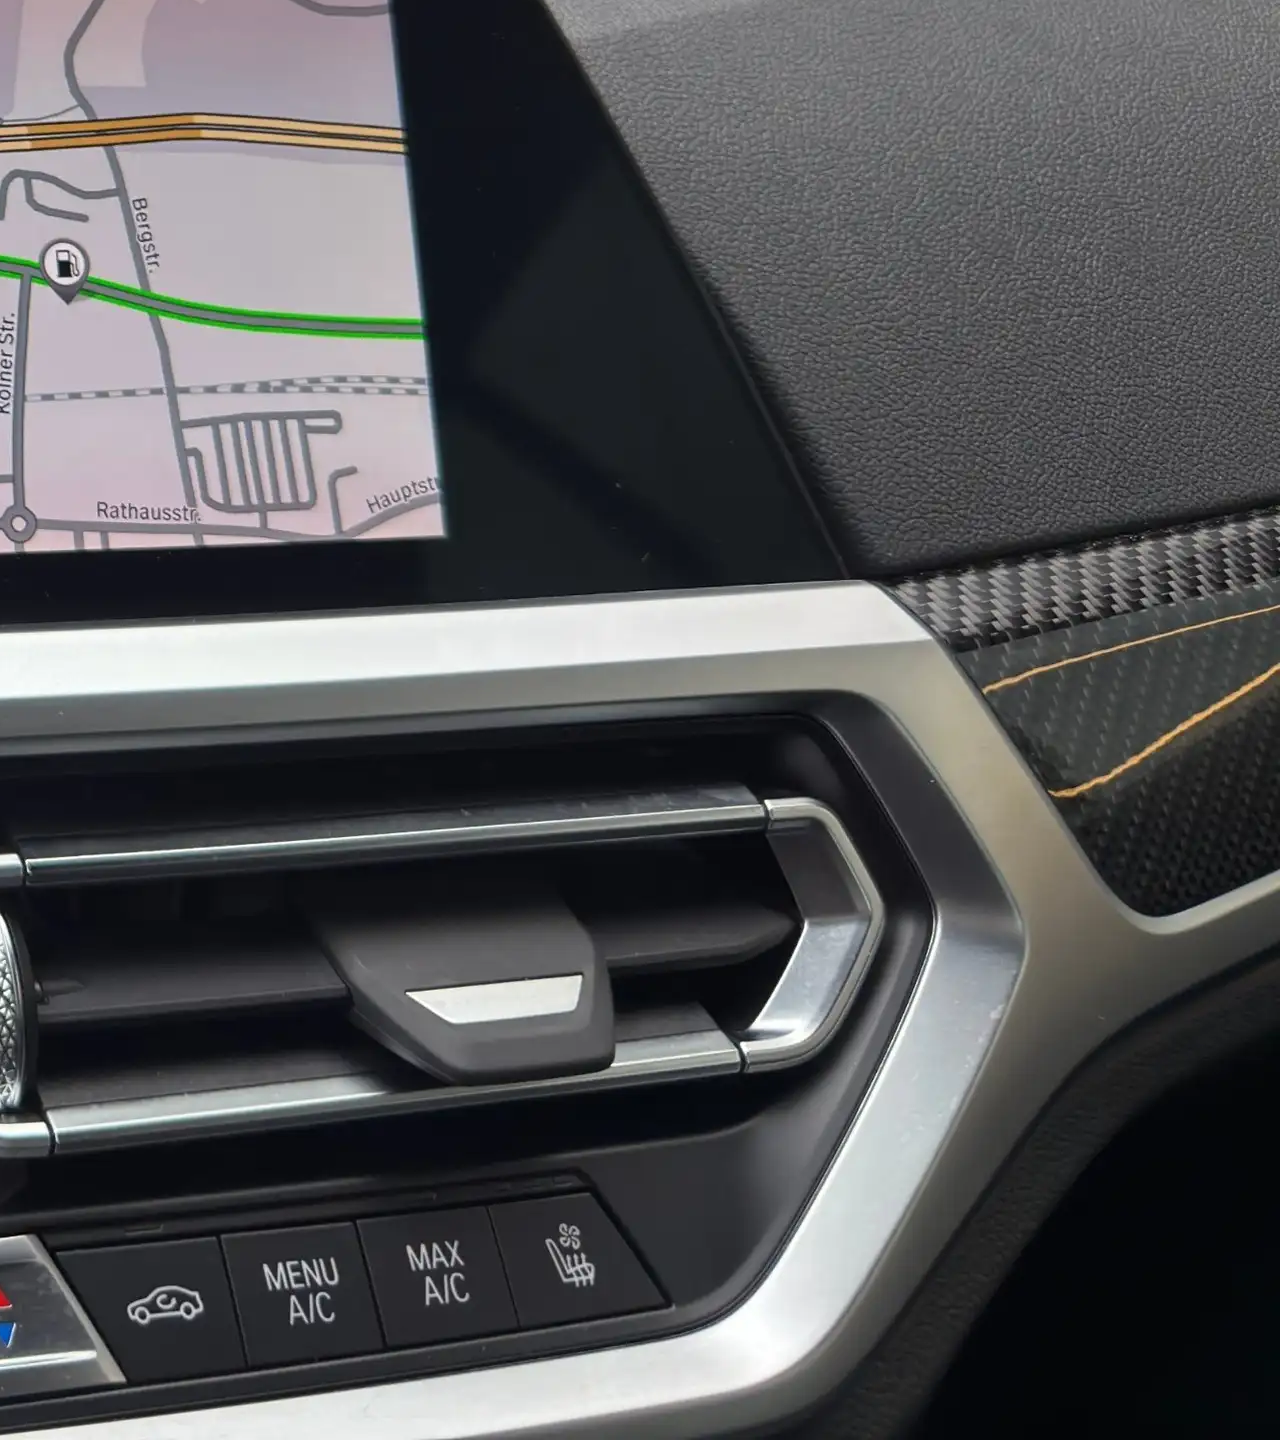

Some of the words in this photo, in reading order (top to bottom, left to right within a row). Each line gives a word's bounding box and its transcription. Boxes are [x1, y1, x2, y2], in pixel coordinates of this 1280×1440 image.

[132, 197, 160, 275] Bergstr.
[95, 500, 202, 523] Rathausstr.
[405, 1239, 466, 1272] MAX
[262, 1256, 340, 1292] MENU
[422, 1271, 471, 1307] A/C
[288, 1290, 336, 1326] A/C
